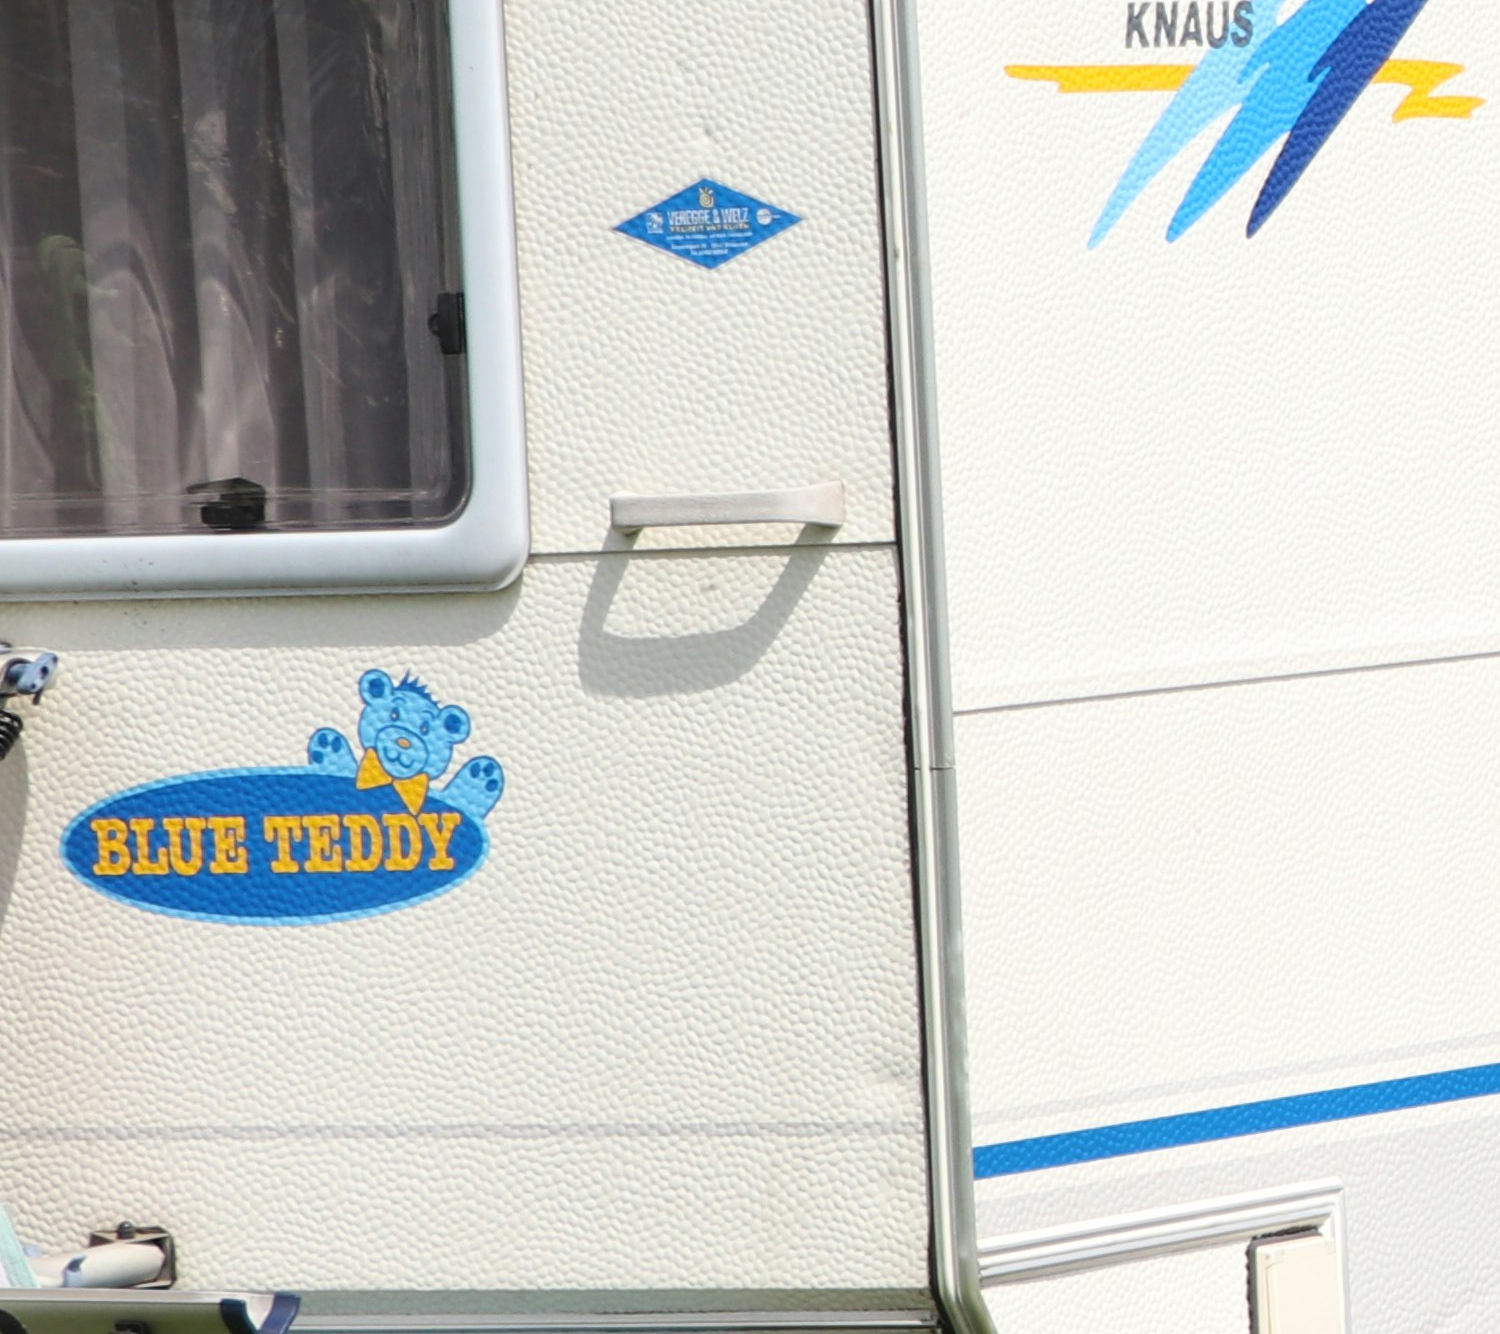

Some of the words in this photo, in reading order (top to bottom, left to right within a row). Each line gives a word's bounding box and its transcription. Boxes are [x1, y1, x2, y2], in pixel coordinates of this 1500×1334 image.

[1124, 0, 1255, 49] KNAUS
[90, 814, 249, 876] BLUE
[263, 812, 462, 875] TEDDY
